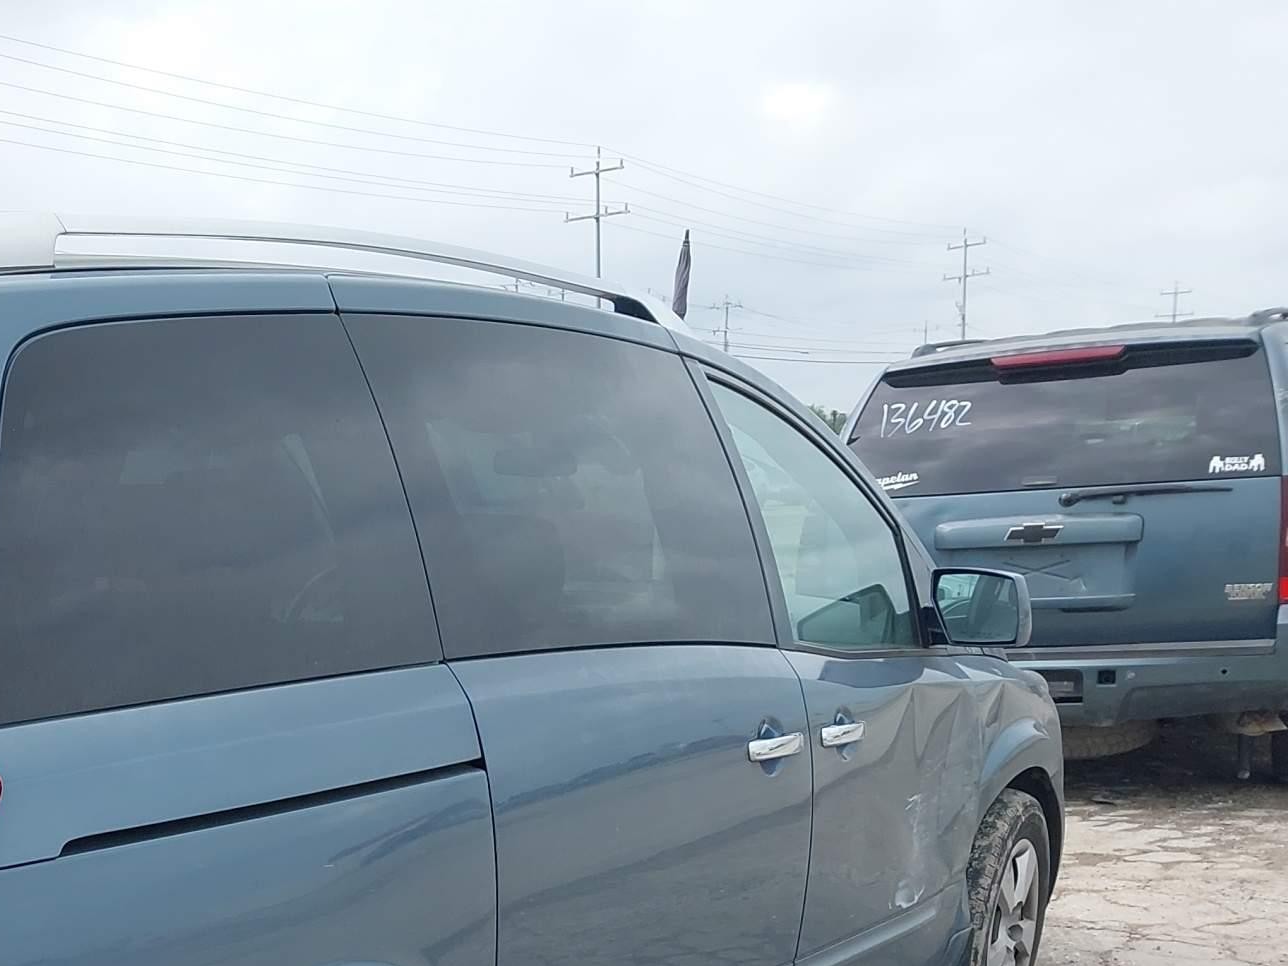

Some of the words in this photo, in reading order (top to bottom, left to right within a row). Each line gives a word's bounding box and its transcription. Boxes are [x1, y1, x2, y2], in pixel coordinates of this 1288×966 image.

[880, 400, 972, 438] 136482
[1225, 463, 1249, 472] DAD
[875, 471, 919, 487] apelan
